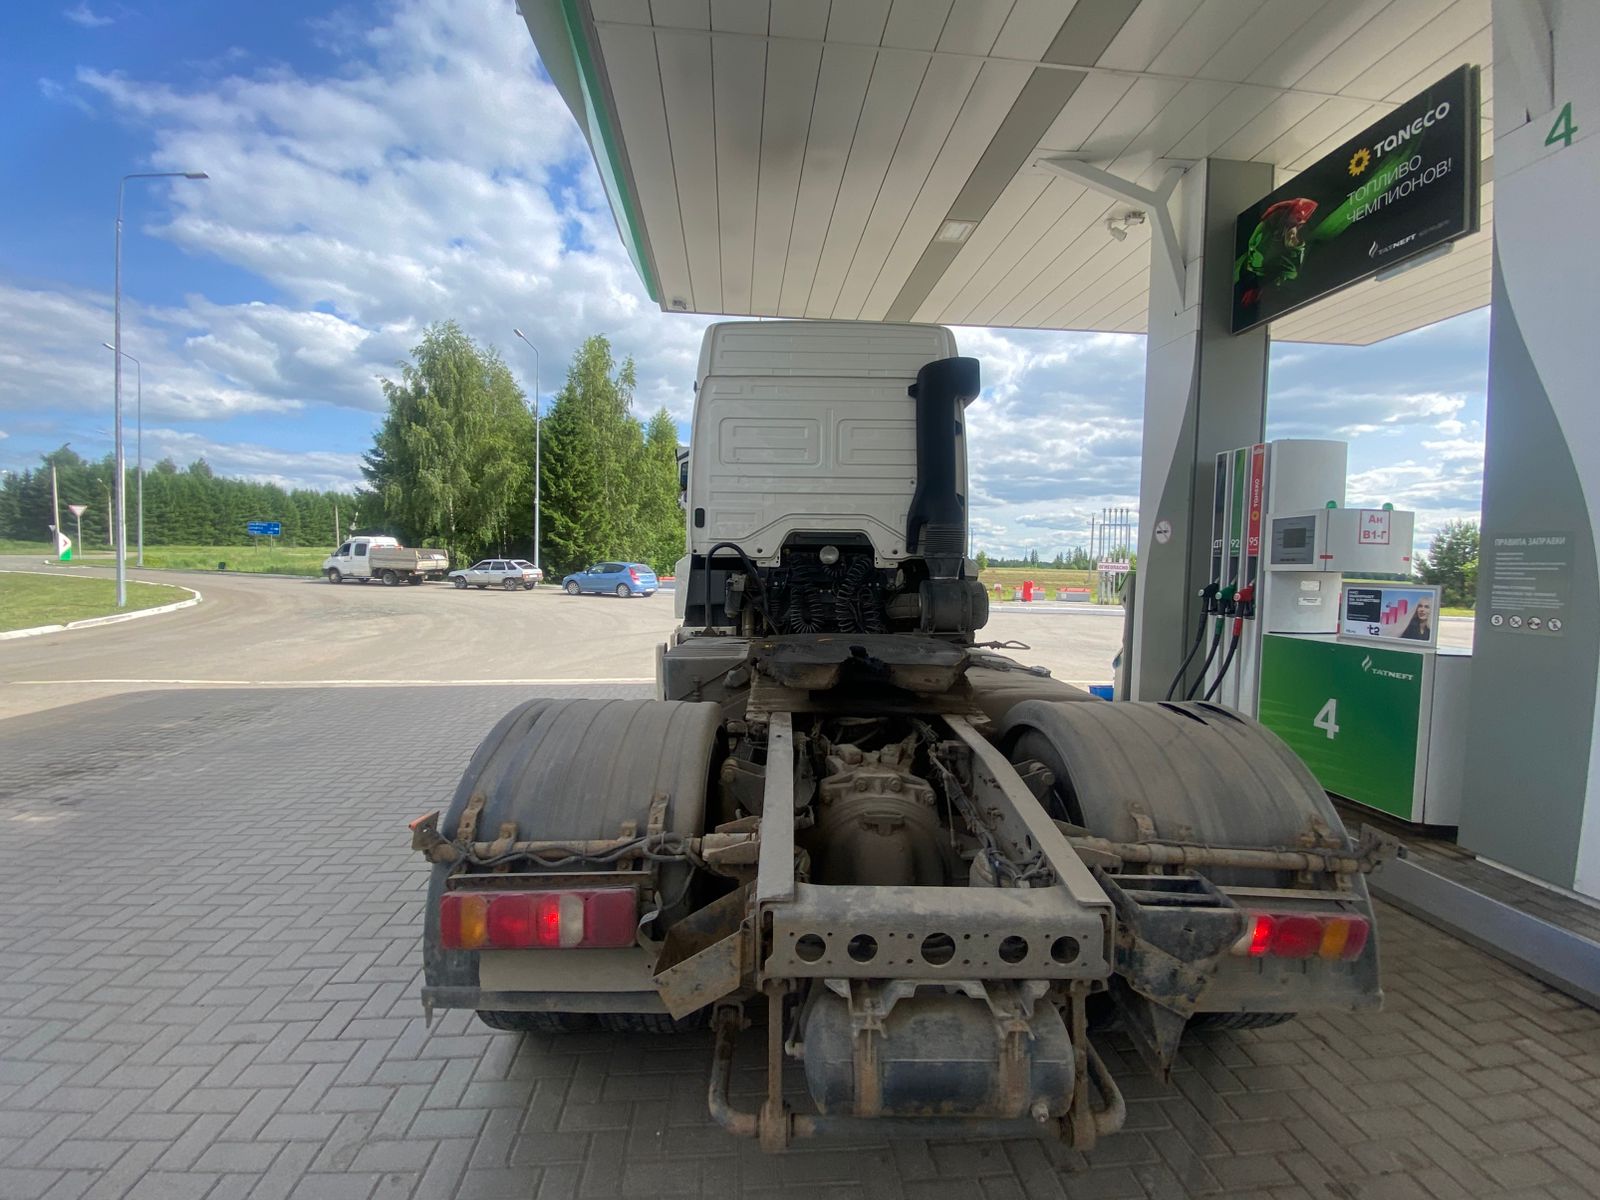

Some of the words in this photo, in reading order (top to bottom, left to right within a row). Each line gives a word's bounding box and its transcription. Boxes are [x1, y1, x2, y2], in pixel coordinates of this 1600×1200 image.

[1543, 102, 1578, 147] 4
[1346, 154, 1422, 205] ТОПЛИВО
[1346, 157, 1452, 222] ЧЕМПИОНОВ!
[1368, 514, 1383, 524] Ан
[1230, 538, 1241, 549] 92
[1248, 536, 1259, 547] 95
[1371, 668, 1415, 681] TATNEFT
[1313, 698, 1340, 740] 4
